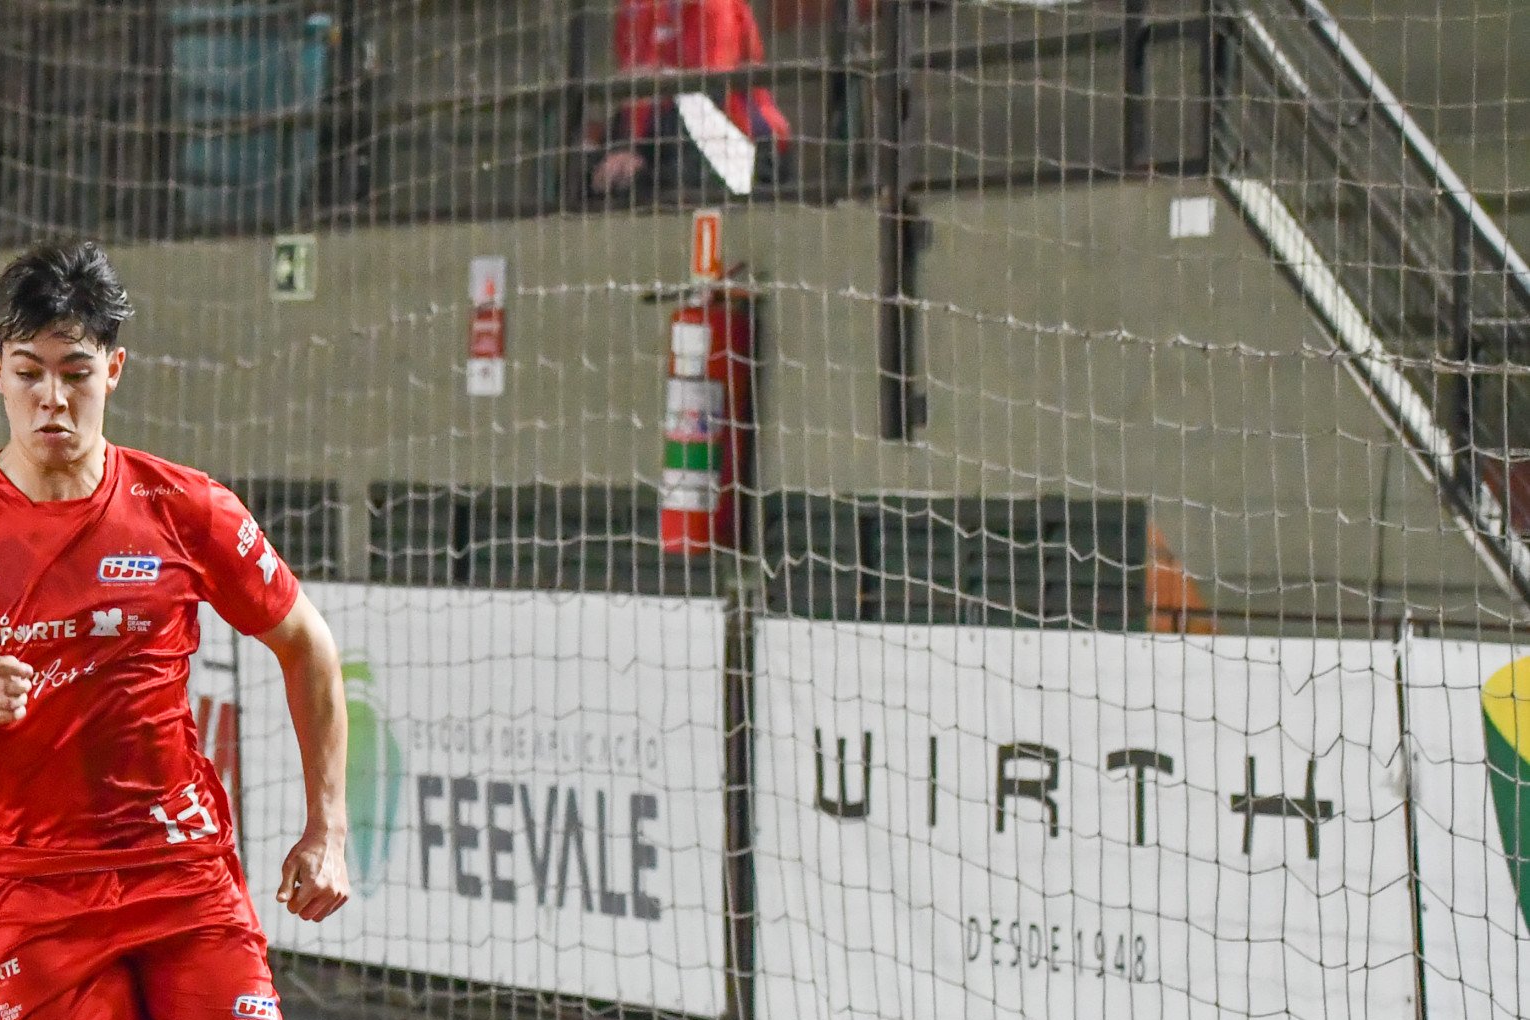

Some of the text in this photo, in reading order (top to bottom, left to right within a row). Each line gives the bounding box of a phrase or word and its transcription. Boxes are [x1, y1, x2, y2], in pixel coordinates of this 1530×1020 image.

[417, 774, 662, 921] FEEVALE
[814, 726, 1334, 860] WIRTH
[968, 917, 1146, 983] DESDE 1948
